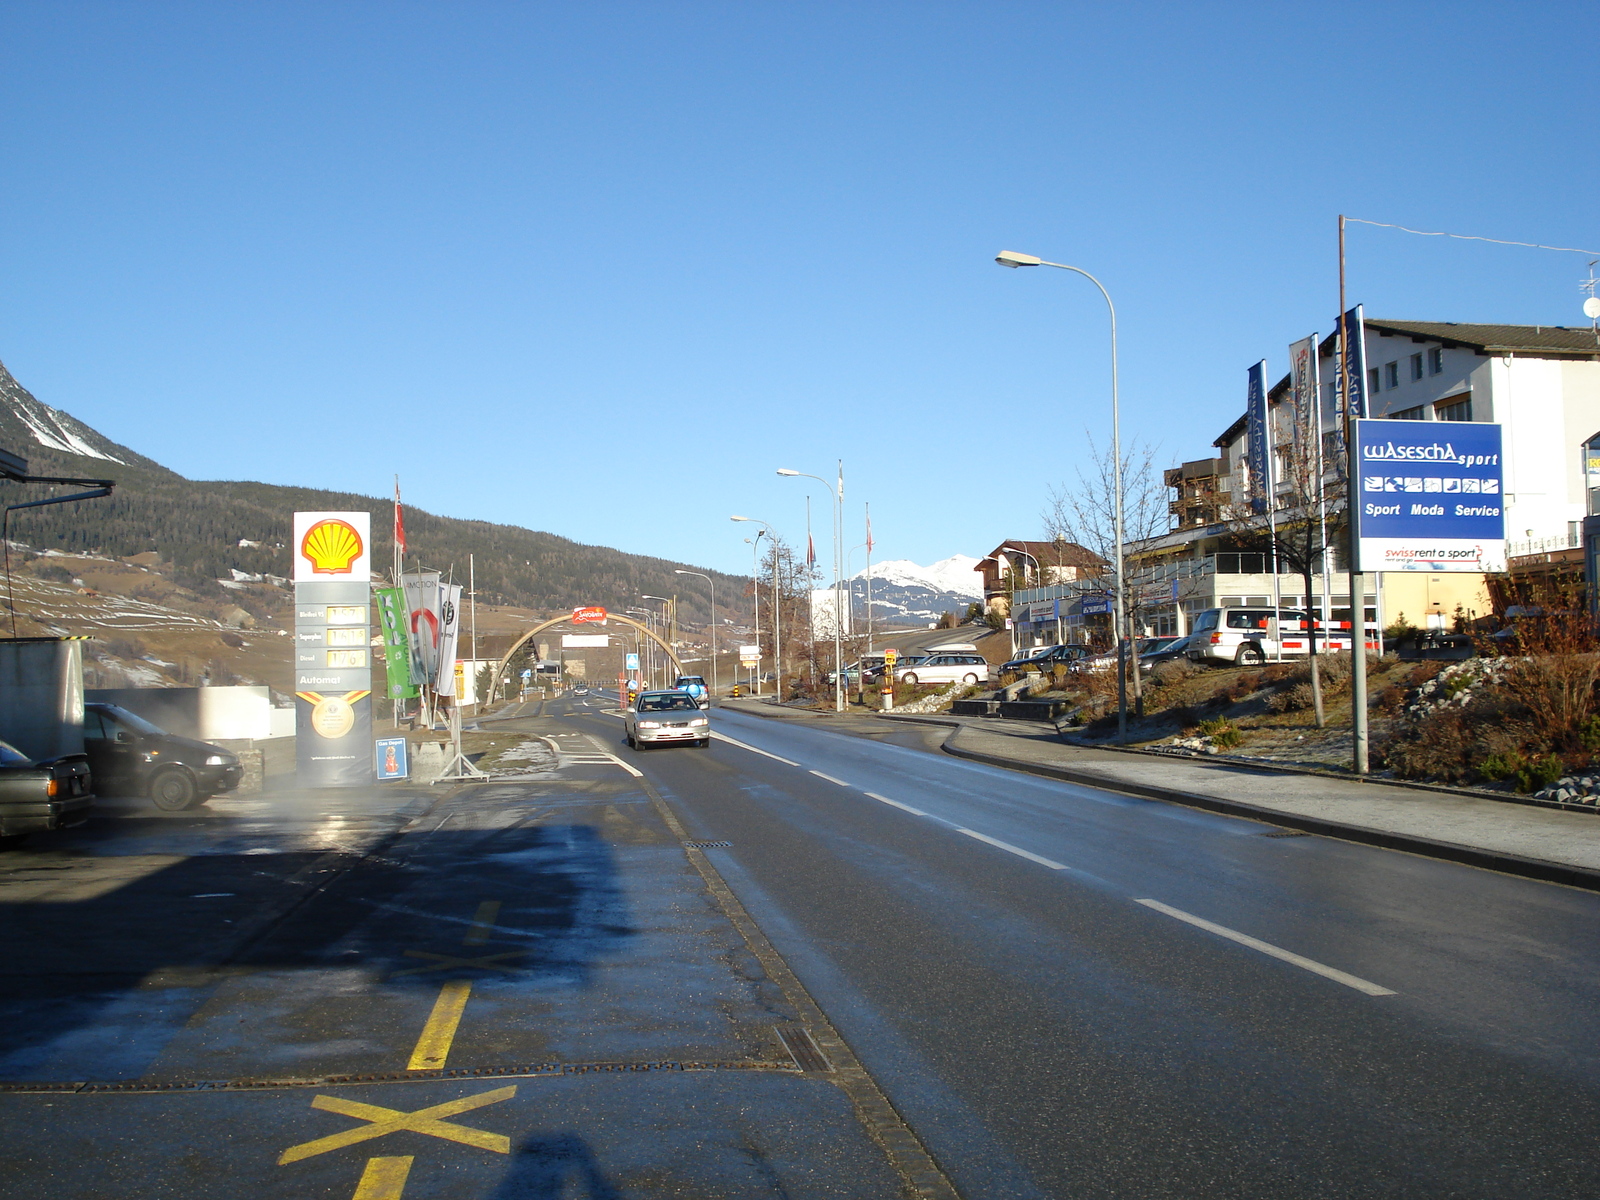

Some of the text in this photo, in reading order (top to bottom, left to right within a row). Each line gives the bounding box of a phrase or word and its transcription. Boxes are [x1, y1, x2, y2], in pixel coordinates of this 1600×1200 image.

[1457, 453, 1498, 468] sport
[1365, 503, 1500, 517] Sport Moda Service
[1438, 550, 1445, 558] a
[1448, 549, 1476, 559] sport
[299, 676, 341, 684] Automat
